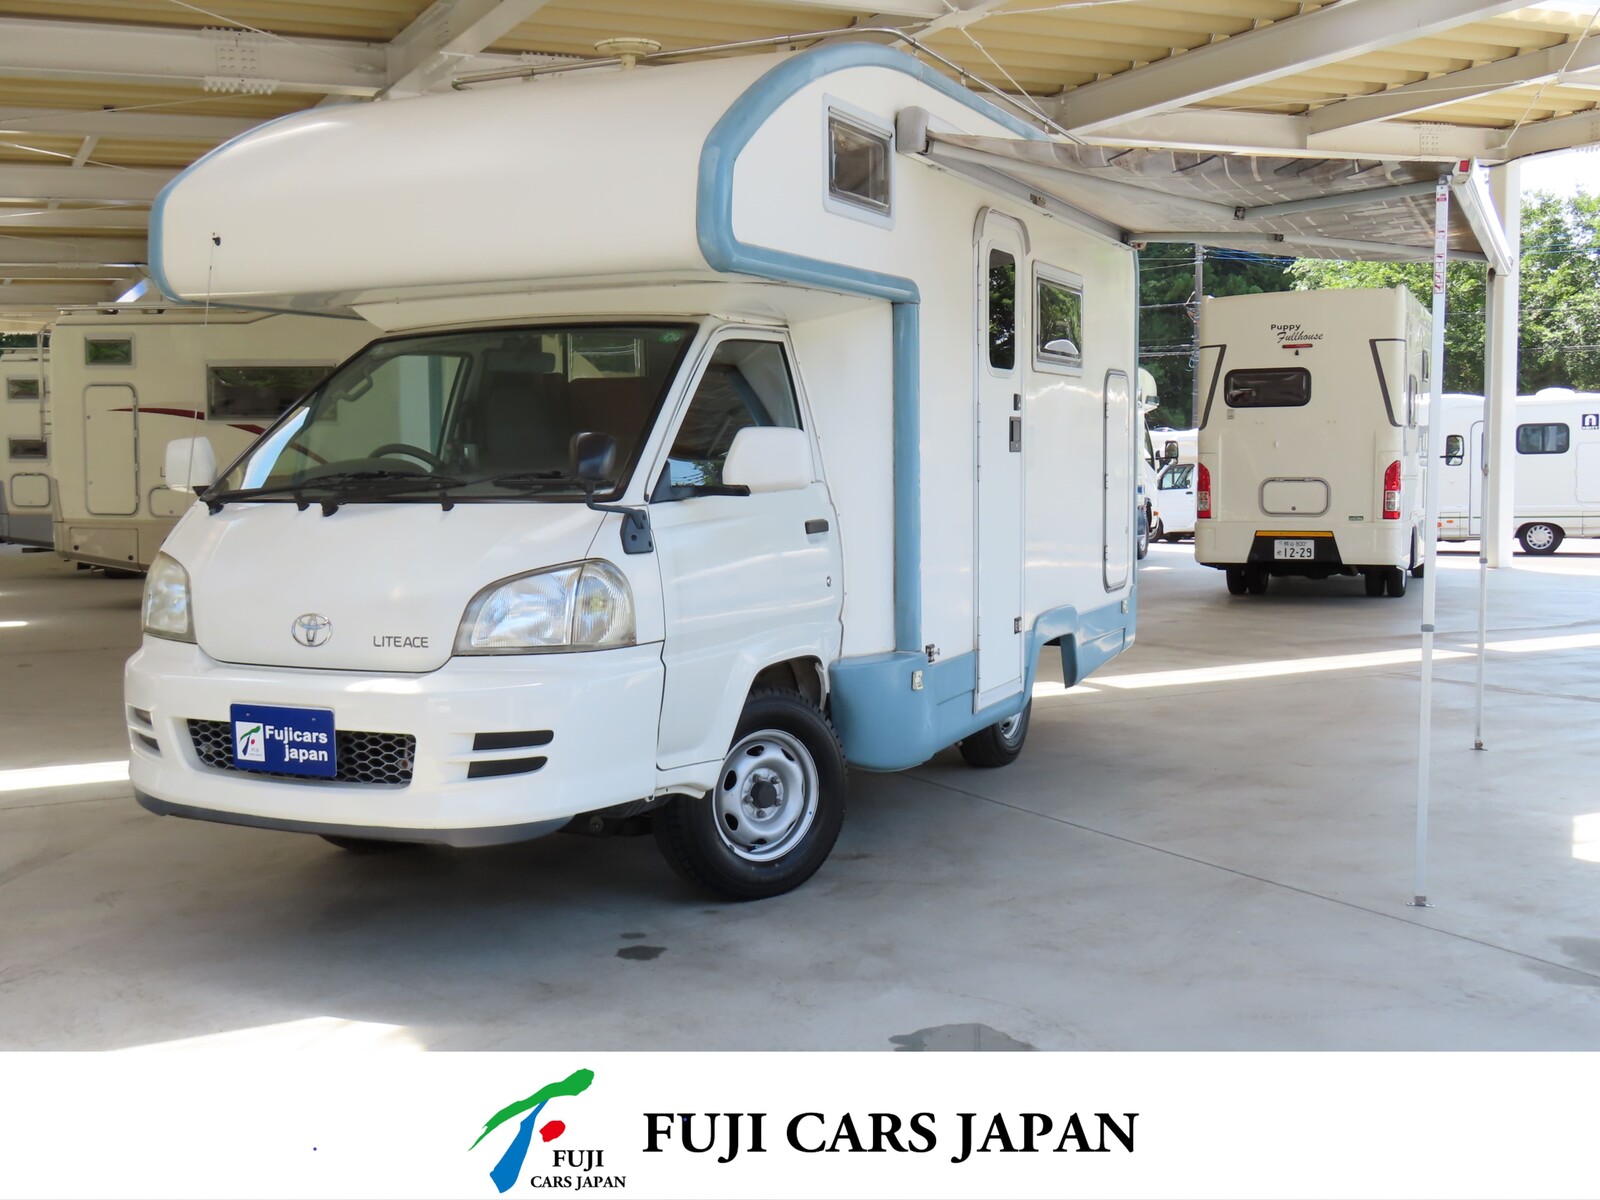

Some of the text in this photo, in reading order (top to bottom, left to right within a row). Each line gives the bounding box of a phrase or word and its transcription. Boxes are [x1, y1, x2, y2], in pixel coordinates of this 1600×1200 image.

[1276, 330, 1324, 343] Fullhouse
[1284, 547, 1312, 558] 12-29
[264, 724, 328, 744] Fujicars
[283, 744, 328, 763] japan
